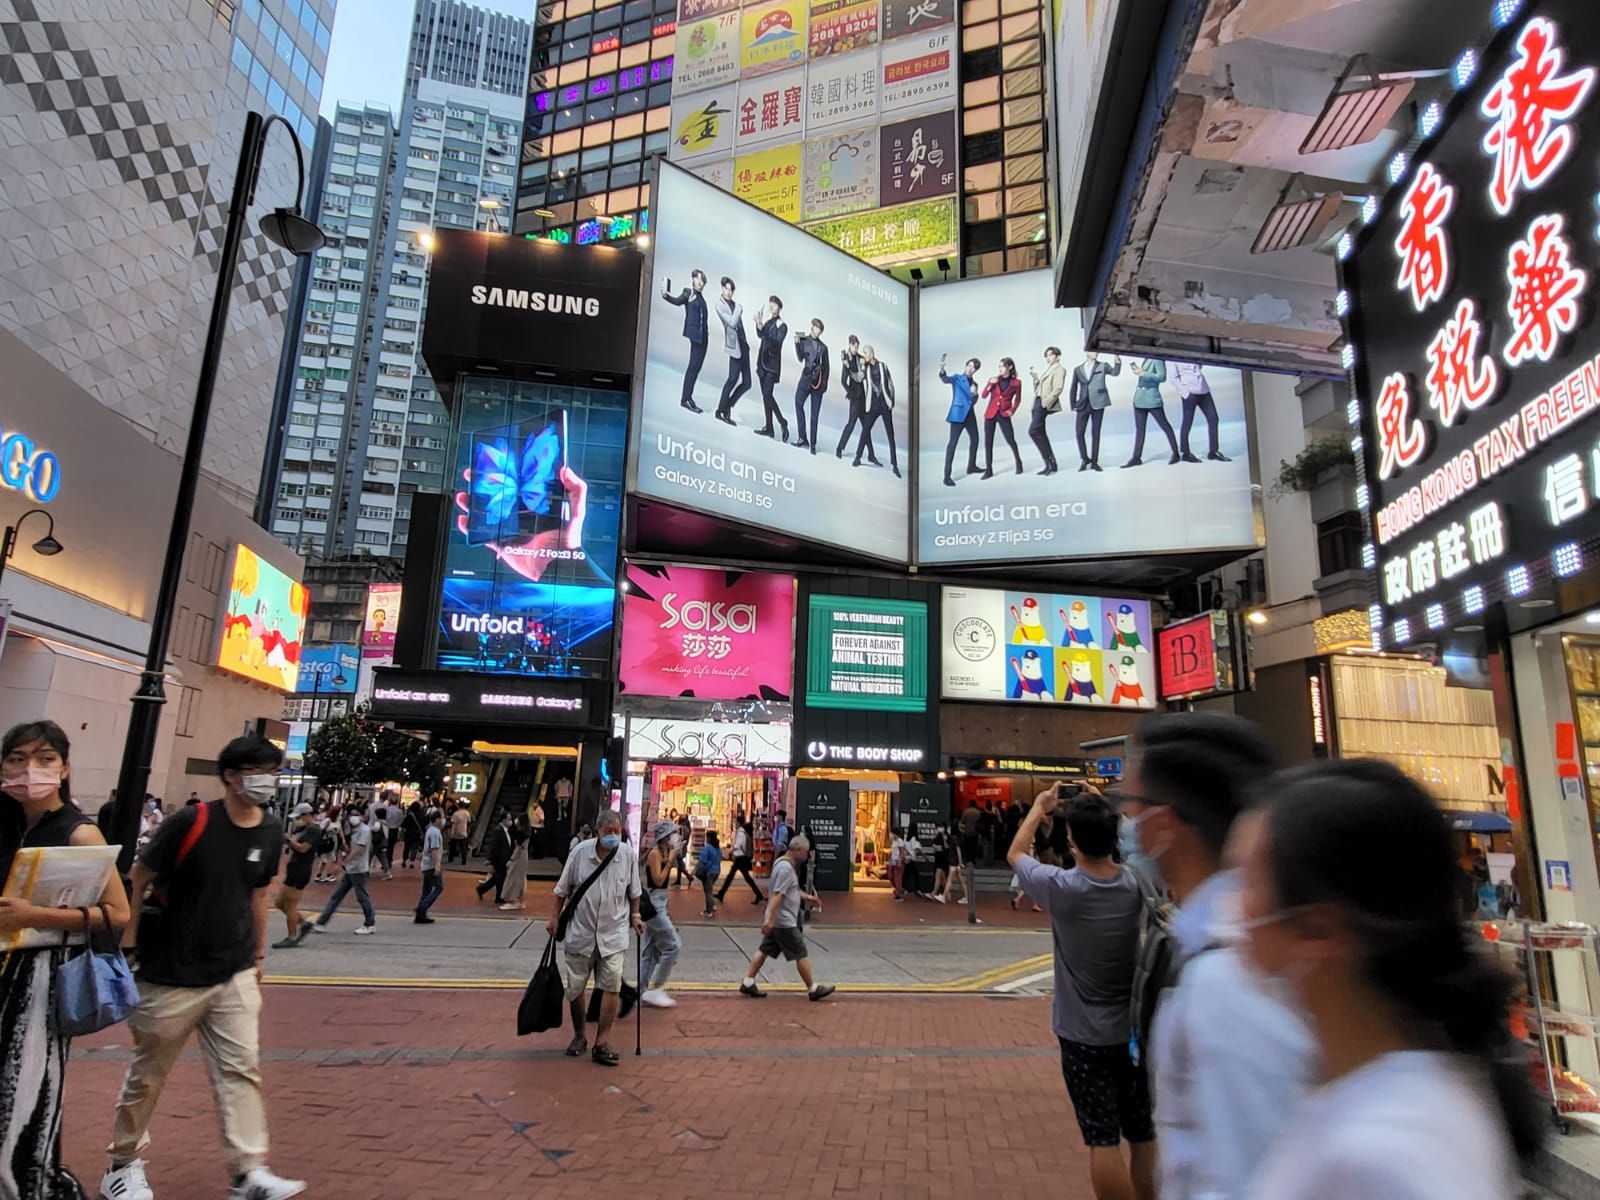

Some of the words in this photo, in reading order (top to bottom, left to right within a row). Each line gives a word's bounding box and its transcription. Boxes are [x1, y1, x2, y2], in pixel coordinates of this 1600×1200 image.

[928, 36, 949, 49] 6/F
[810, 68, 876, 108] 韓國料理
[739, 86, 802, 136] 金羅寶
[1395, 16, 1595, 312] 香港
[780, 183, 798, 199] 5/F
[940, 172, 954, 186] 5F
[470, 284, 601, 318] SAMSUNG
[848, 272, 899, 306] SAMSUNG
[0, 424, 61, 503] GO
[656, 432, 726, 472] Unfold
[729, 459, 758, 482] an
[761, 471, 797, 494] era
[654, 464, 707, 494] Galaxy
[707, 479, 717, 494] Z
[717, 482, 754, 504] Fold3
[754, 493, 774, 510] 5G
[1376, 485, 1424, 545] HONG
[1420, 448, 1479, 516] KONG
[1473, 413, 1527, 480] TAX
[934, 504, 1005, 526] Unfold
[1009, 504, 1041, 521] an
[1045, 500, 1088, 518] era
[934, 533, 986, 548] Galaxy
[986, 531, 996, 544] Z
[998, 528, 1031, 545] Flip3
[1033, 528, 1055, 541] 5G
[504, 545, 539, 558] Galaxy
[539, 548, 546, 557] Z
[571, 551, 586, 560] 5G
[1383, 500, 1504, 606] 政府註冊
[450, 612, 526, 635] Unfold
[681, 632, 732, 660] 莎莎
[834, 636, 869, 650] FOREVER
[869, 639, 901, 651] AGAINST
[1170, 633, 1199, 677] iB
[831, 650, 867, 665] ANIMAL
[866, 652, 904, 668] TESTING
[693, 664, 710, 679] life
[711, 665, 751, 681] beautiful
[375, 688, 410, 700] Unfold
[411, 691, 427, 701] an
[428, 692, 450, 702] era
[480, 693, 534, 706] SAMSUNG
[536, 695, 572, 710] Galaxy
[829, 745, 853, 759] THE
[856, 747, 888, 760] BODY
[890, 749, 923, 761] SHOP
[455, 772, 478, 793] iB
